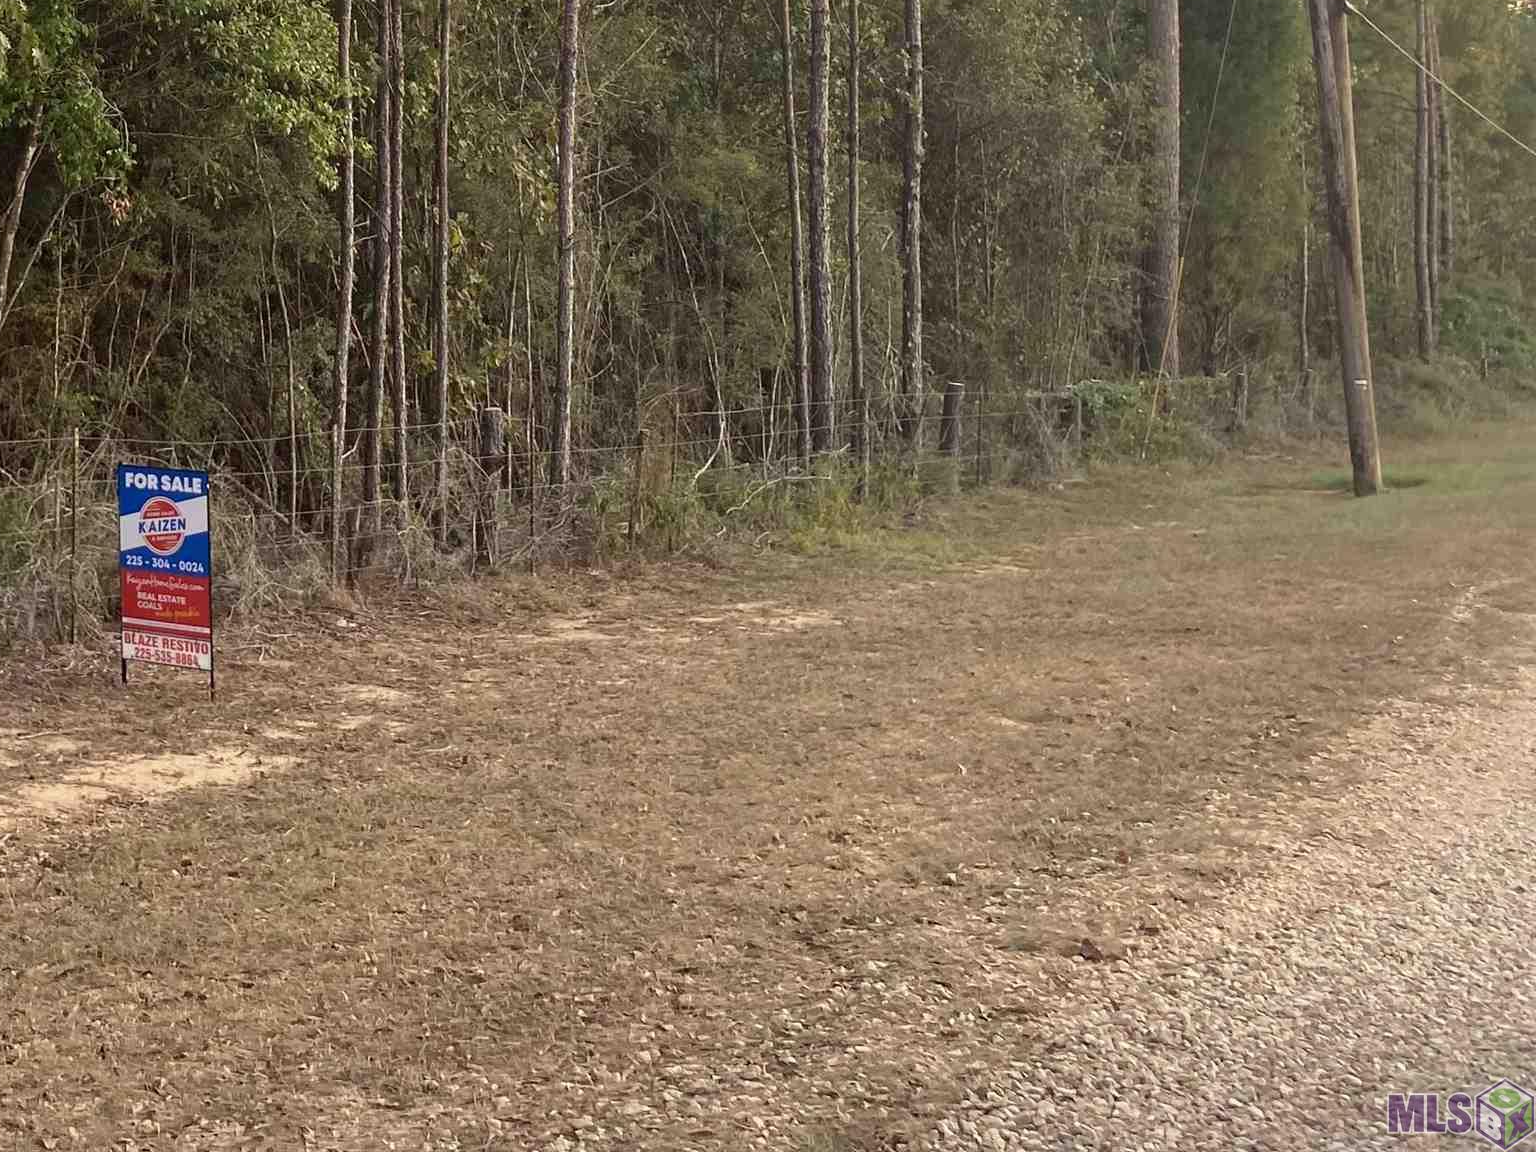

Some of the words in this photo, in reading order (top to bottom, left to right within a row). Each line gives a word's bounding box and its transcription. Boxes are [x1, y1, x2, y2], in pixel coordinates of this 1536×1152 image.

[125, 472, 158, 490] FOR
[160, 475, 202, 494] SALE
[138, 518, 186, 534] KAIZEN
[126, 555, 143, 566] 225
[151, 557, 170, 569] 304
[178, 561, 204, 573] 0024
[137, 591, 157, 602] REAL
[157, 594, 186, 605] ESTATE
[123, 632, 159, 648] BLAZE
[161, 638, 209, 655] RESTIVO
